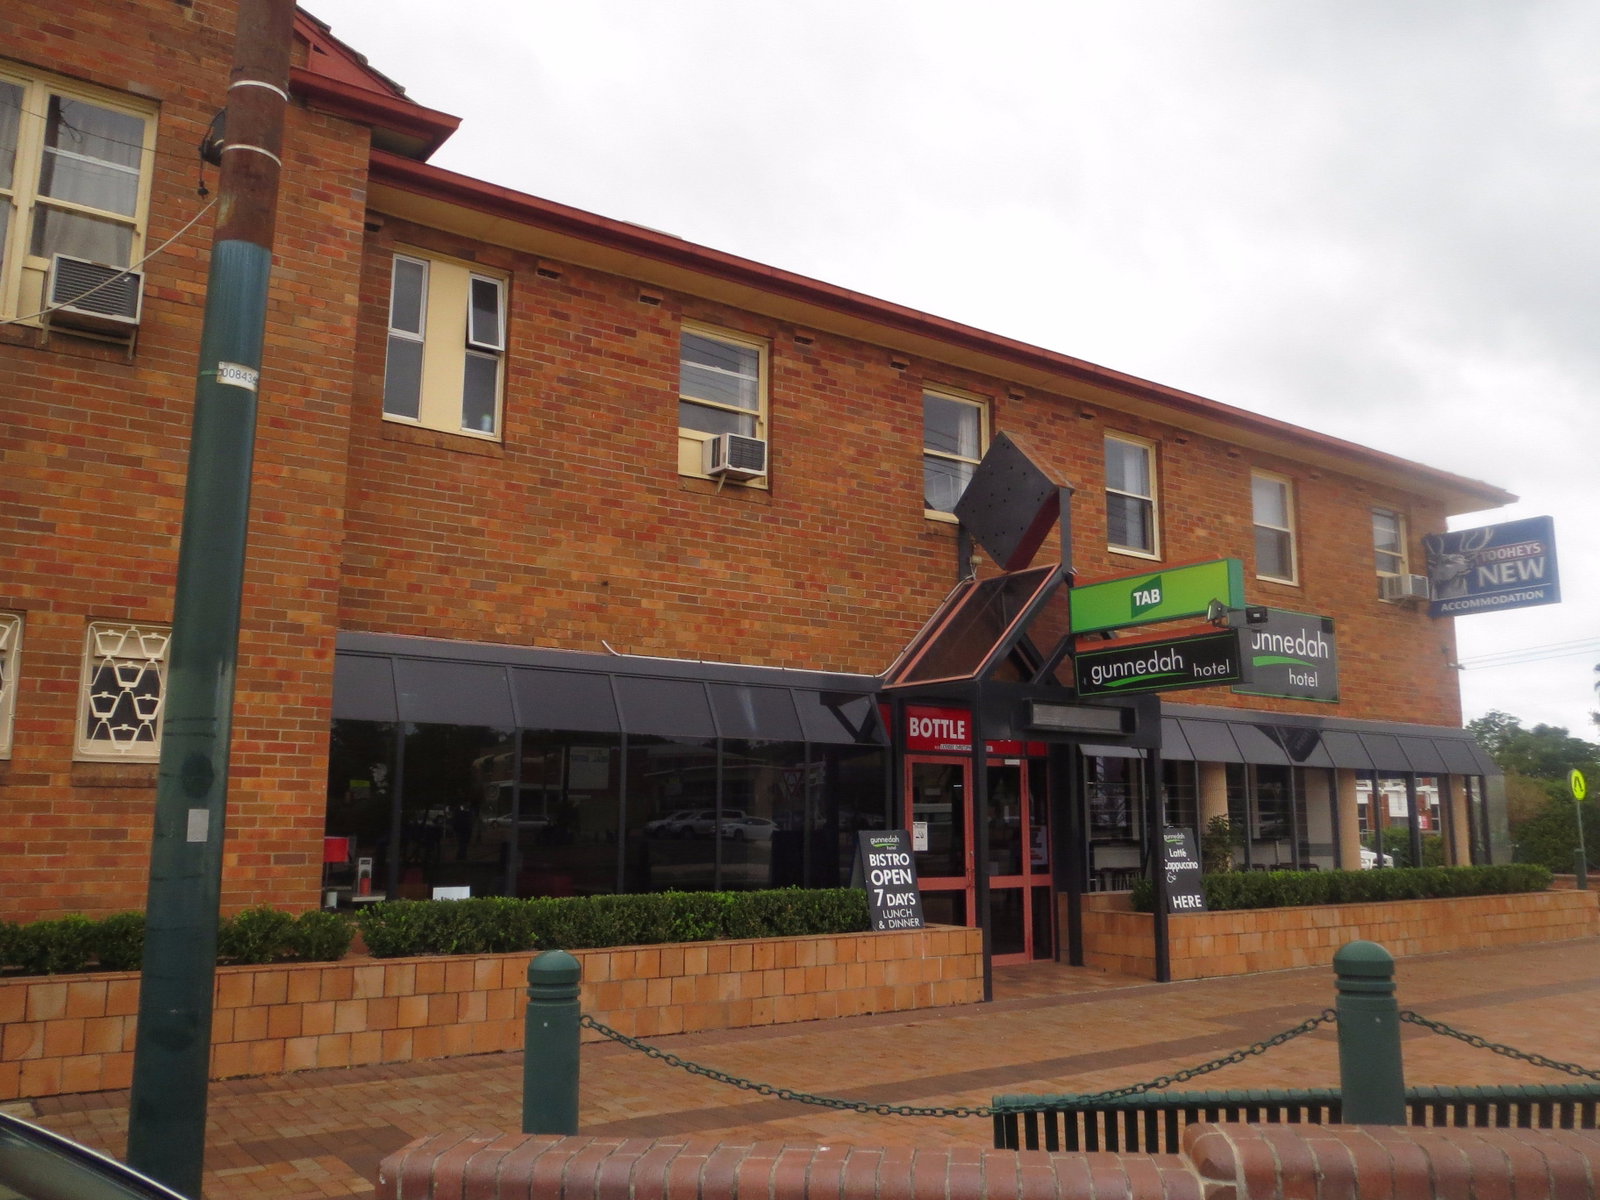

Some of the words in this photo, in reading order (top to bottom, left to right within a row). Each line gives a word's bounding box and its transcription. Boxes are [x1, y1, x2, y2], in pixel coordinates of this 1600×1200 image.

[1480, 542, 1542, 563] TOOHEYS
[1477, 556, 1545, 587] NEW
[1133, 588, 1161, 606] TAB
[1440, 590, 1544, 612] ACCOMMODATION
[1251, 628, 1329, 659] unnedah
[1091, 648, 1184, 685] gunnedah
[1193, 659, 1230, 678] hotel
[1288, 667, 1319, 688] hotel
[909, 717, 966, 740] BOTTLE
[870, 835, 900, 845] gunnedah
[868, 853, 910, 867] BISTRO
[870, 868, 913, 886] OPEN
[873, 888, 884, 907] 7
[886, 892, 916, 907] DAYS
[1172, 894, 1203, 909] HERE
[882, 908, 913, 919] LUNCH
[878, 920, 885, 930] &
[888, 917, 921, 929] DINNER
